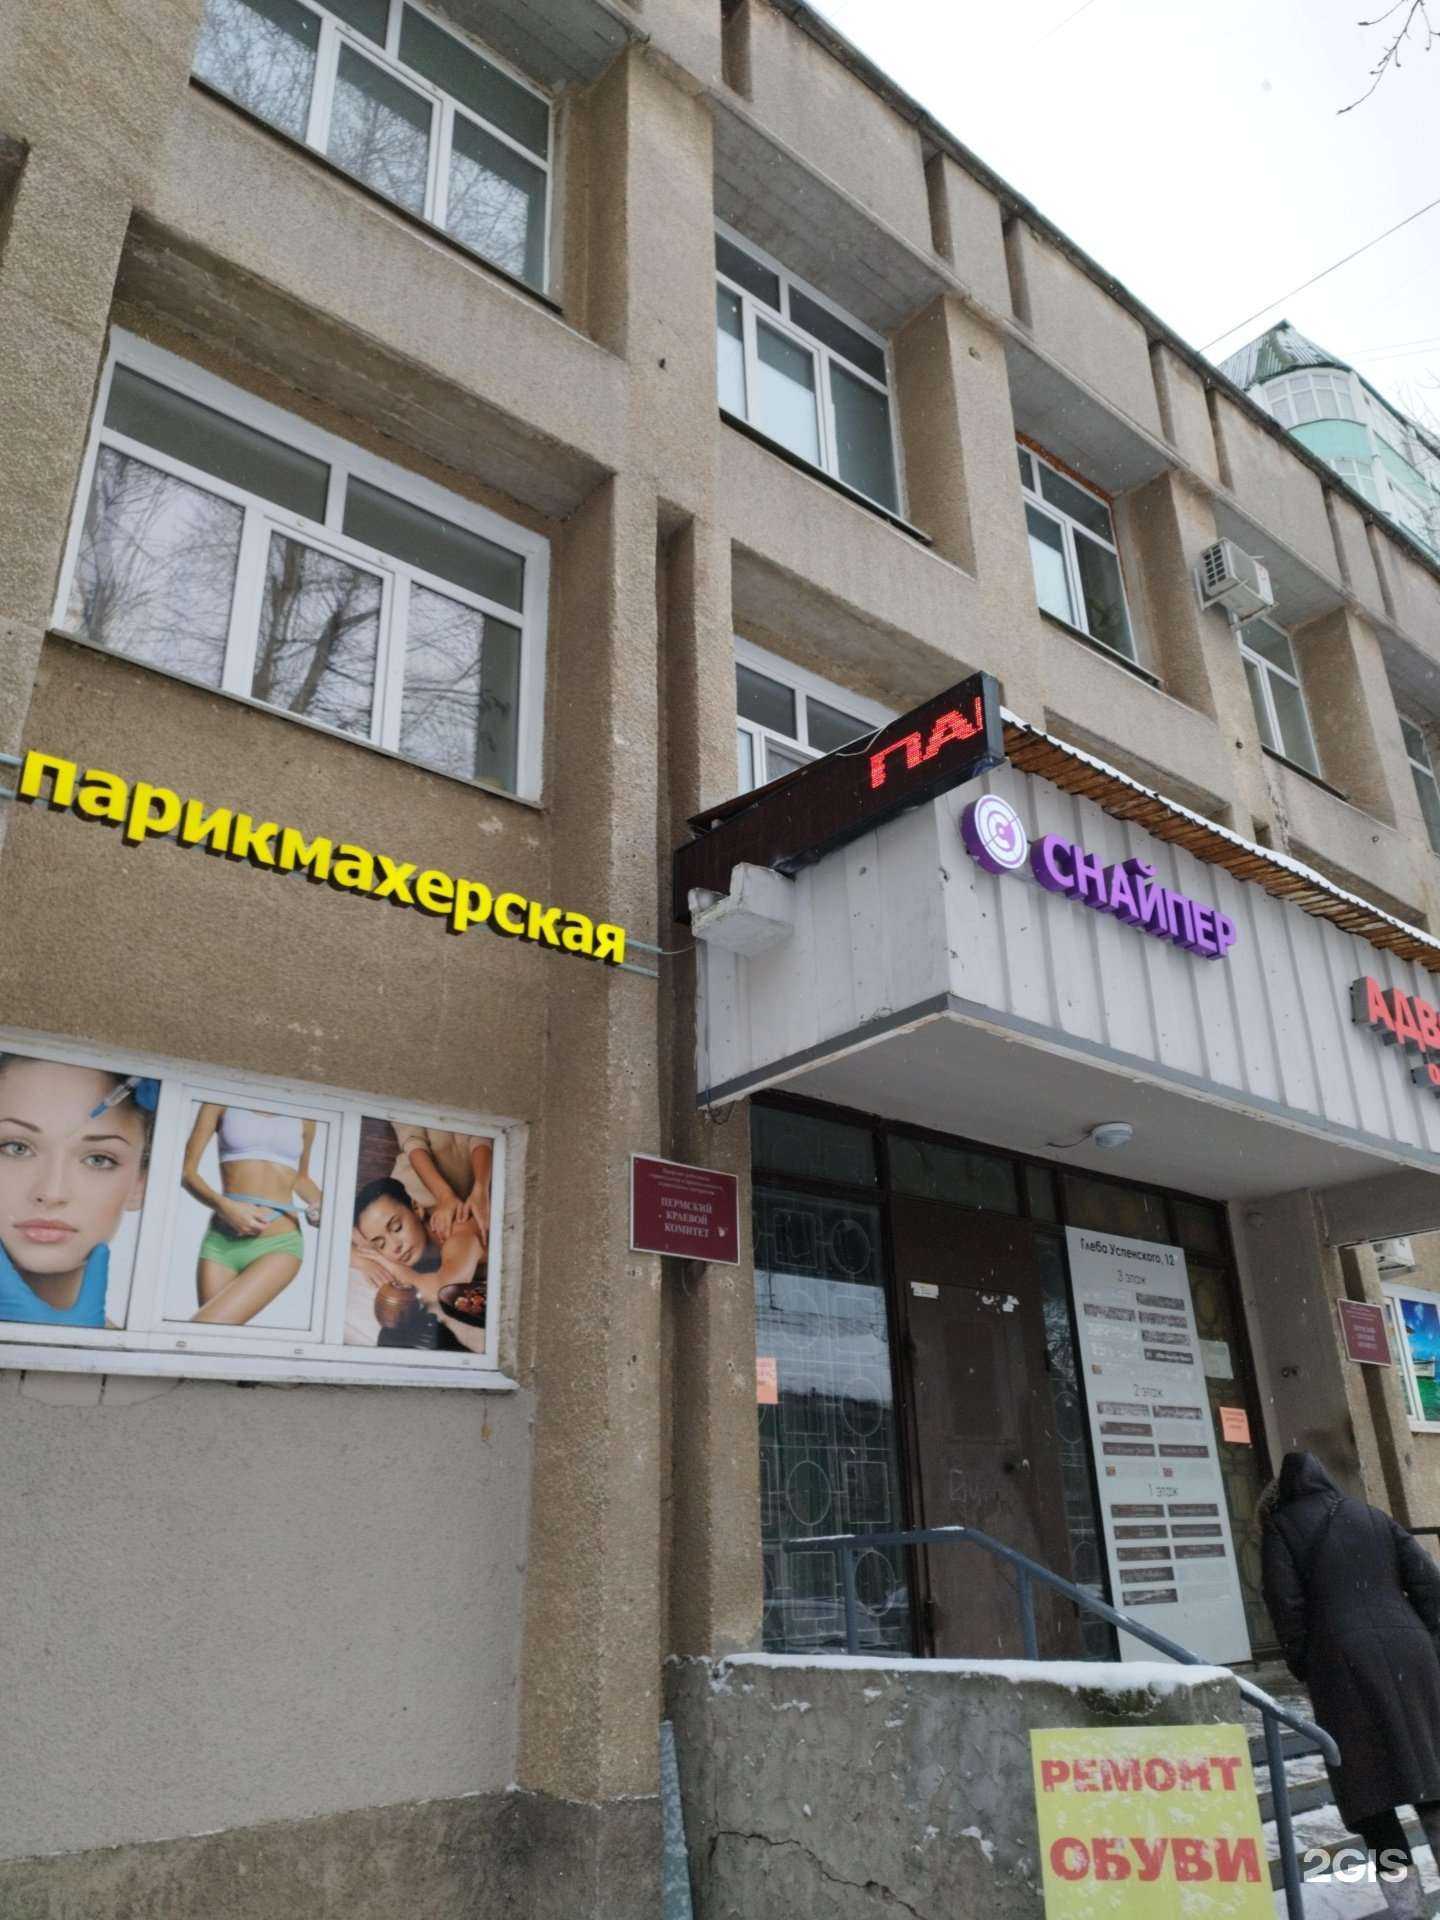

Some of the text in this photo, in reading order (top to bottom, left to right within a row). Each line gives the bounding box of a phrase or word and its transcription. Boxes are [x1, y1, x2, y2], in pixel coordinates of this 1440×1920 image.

[19, 750, 627, 965] парикмахерская
[1036, 833, 1237, 959] СНАЙПЕР
[1365, 975, 1440, 1053] АДВ
[661, 1197, 712, 1213] ПЕРМСКИЙ
[665, 1210, 708, 1225] КРАЕВОЙ
[664, 1222, 709, 1238] КОМИТЕТ
[1080, 1238, 1108, 1254] Глеба
[1164, 1253, 1175, 1266] 12
[1040, 1756, 1243, 1793] РЕМОНТ
[1049, 1837, 1263, 1883] ОБУВИ
